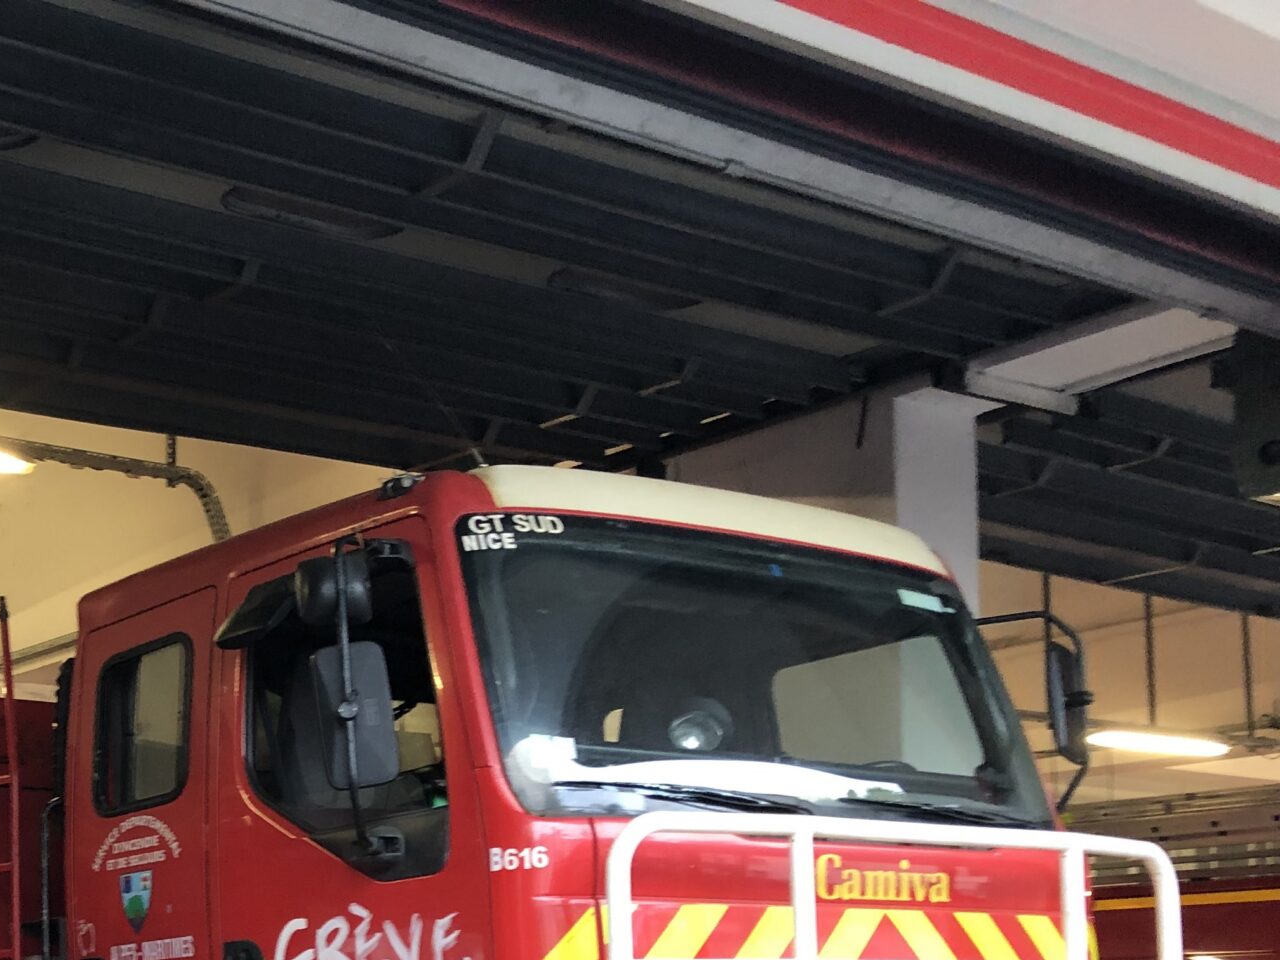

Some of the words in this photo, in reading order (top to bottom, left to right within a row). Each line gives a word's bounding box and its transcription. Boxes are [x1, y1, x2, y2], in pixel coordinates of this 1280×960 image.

[468, 514, 505, 534] GT
[512, 514, 565, 534] SUD
[461, 533, 517, 551] NICE
[489, 845, 550, 872] B616
[816, 853, 952, 903] Camiva
